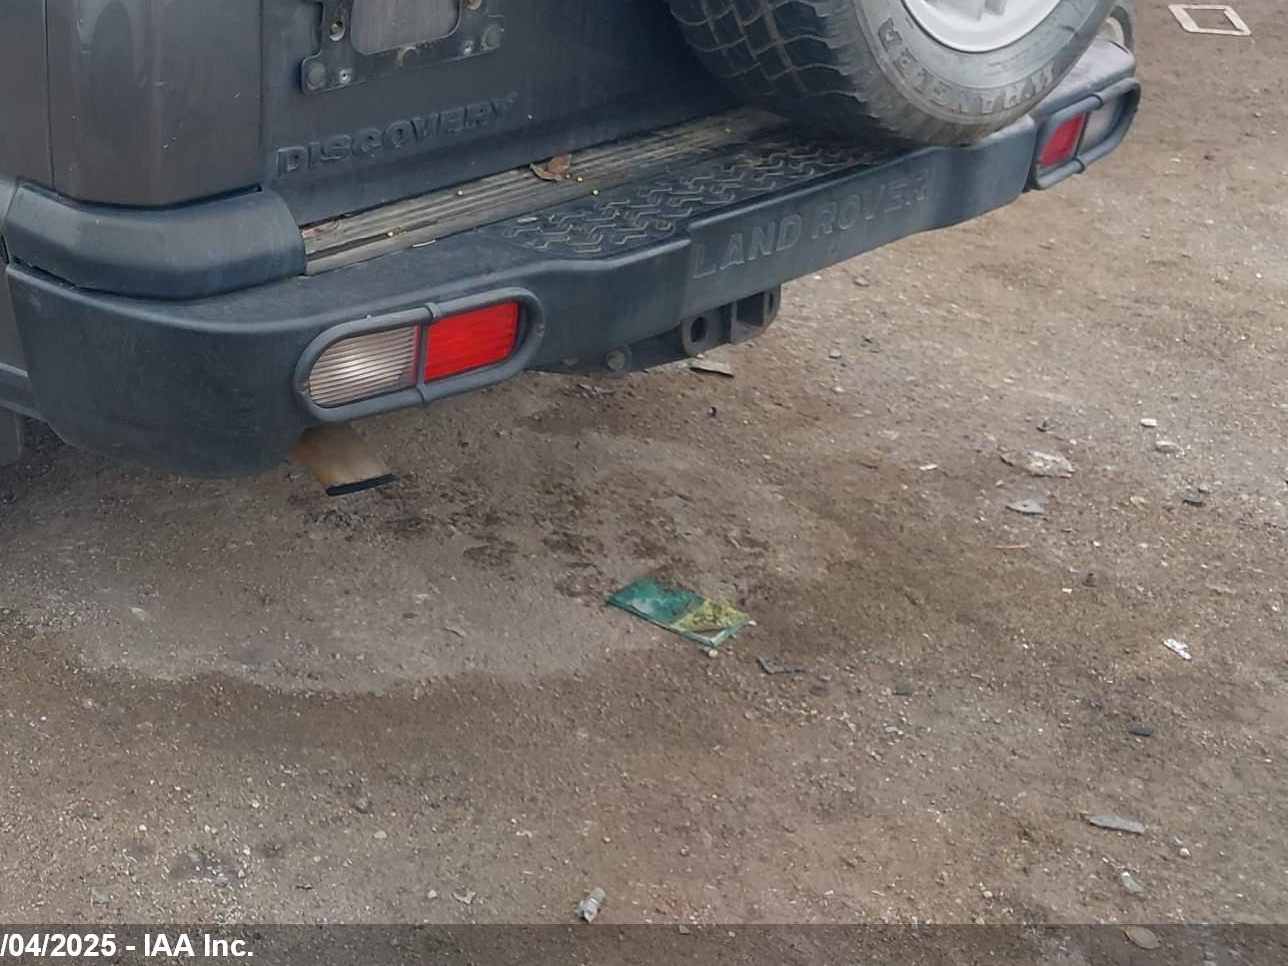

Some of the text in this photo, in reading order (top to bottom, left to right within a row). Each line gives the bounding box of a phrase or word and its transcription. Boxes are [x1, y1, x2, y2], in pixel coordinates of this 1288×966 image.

[276, 91, 518, 177] DISCOVERY
[692, 169, 934, 279] LAND ROVER
